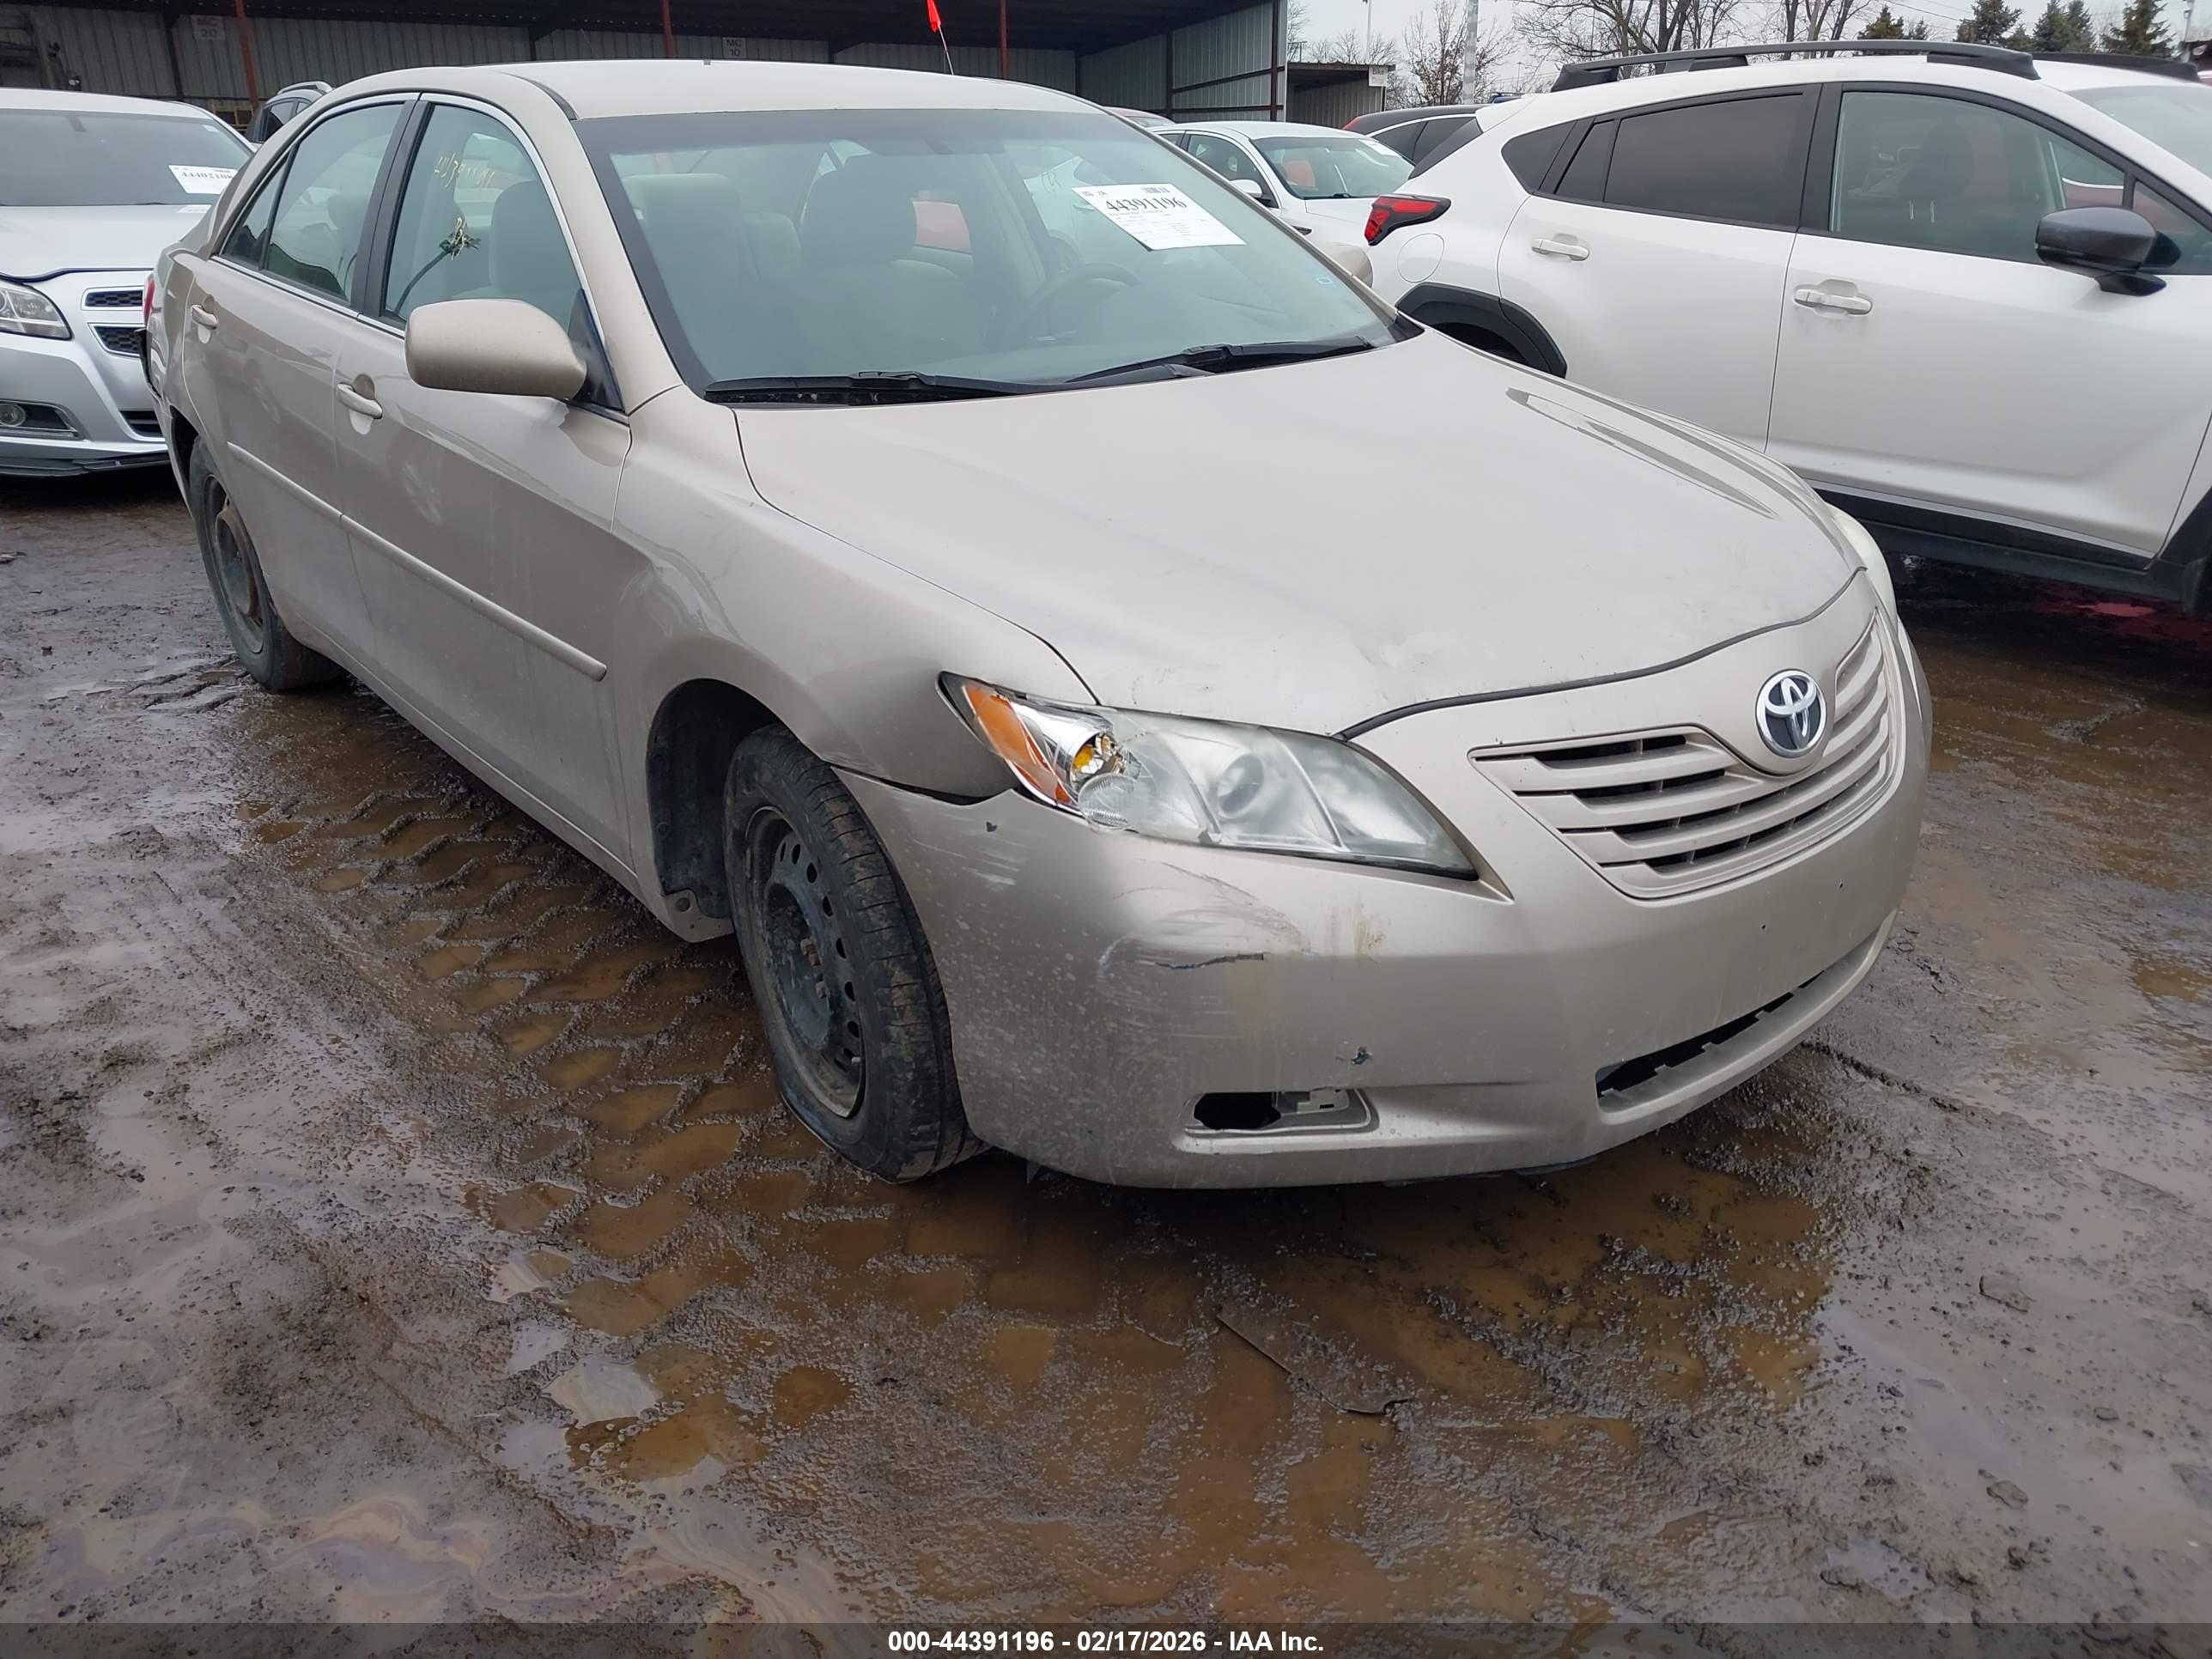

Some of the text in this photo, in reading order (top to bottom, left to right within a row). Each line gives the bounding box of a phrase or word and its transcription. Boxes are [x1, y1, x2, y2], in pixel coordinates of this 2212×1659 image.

[198, 17, 218, 27] MC
[200, 28, 218, 38] 20
[726, 39, 743, 47] MC
[1105, 197, 1188, 212] 44391196
